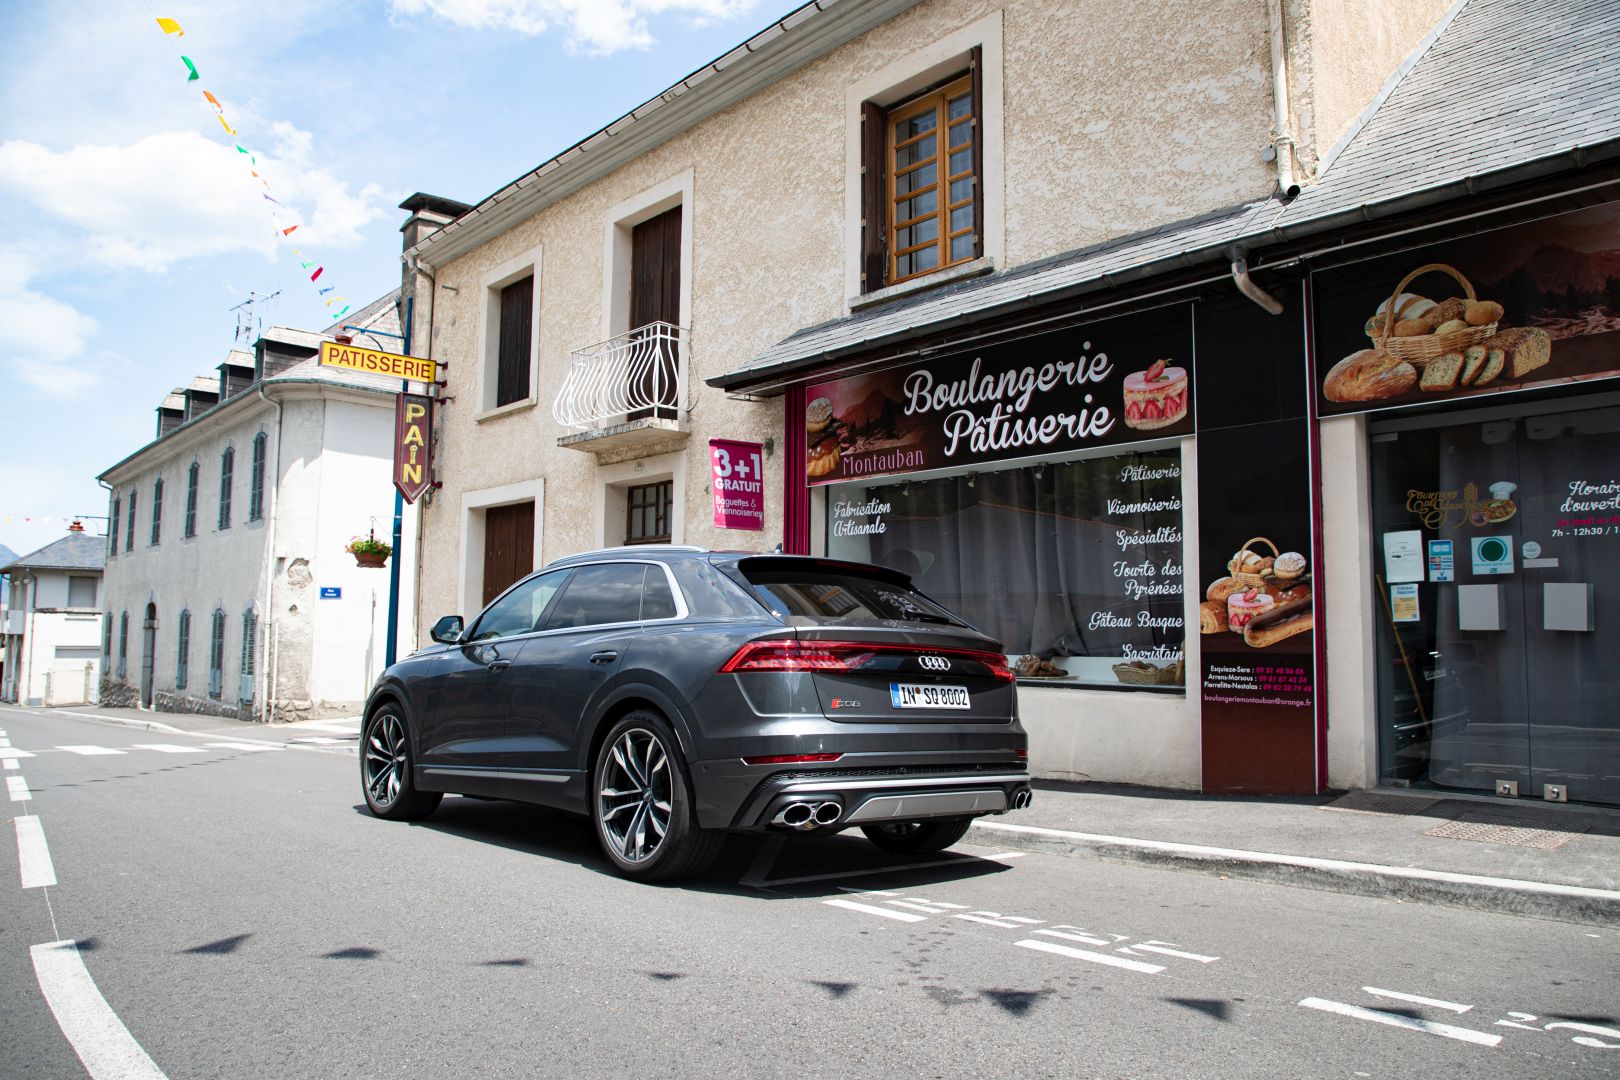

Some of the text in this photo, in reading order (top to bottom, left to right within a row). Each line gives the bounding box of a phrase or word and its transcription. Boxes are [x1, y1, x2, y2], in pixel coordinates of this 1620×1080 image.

[328, 347, 432, 379] PATISSERIE
[904, 341, 1114, 415] Boulangerie
[944, 394, 1117, 457] Pâtisserie
[714, 449, 761, 480] 3+1
[843, 448, 924, 476] Montauban
[1121, 464, 1182, 482] Pâtisserie
[714, 477, 761, 493] GRATUIT
[715, 495, 749, 507] Baguettes
[833, 497, 891, 519] Fabrication
[1107, 496, 1182, 515] Viennoiserie
[833, 515, 887, 537] Artisanale
[1552, 529, 1563, 537] 7h
[1574, 527, 1603, 536] 12h30
[1116, 527, 1182, 552] Spécialités
[1113, 559, 1183, 577] Tourte des
[1125, 579, 1183, 600] Pyrénées
[1089, 611, 1184, 634] Gâteau Basque
[1122, 644, 1184, 660] Sacristain
[901, 687, 916, 704] IN
[923, 688, 939, 705] SQ
[941, 689, 967, 705] 8002
